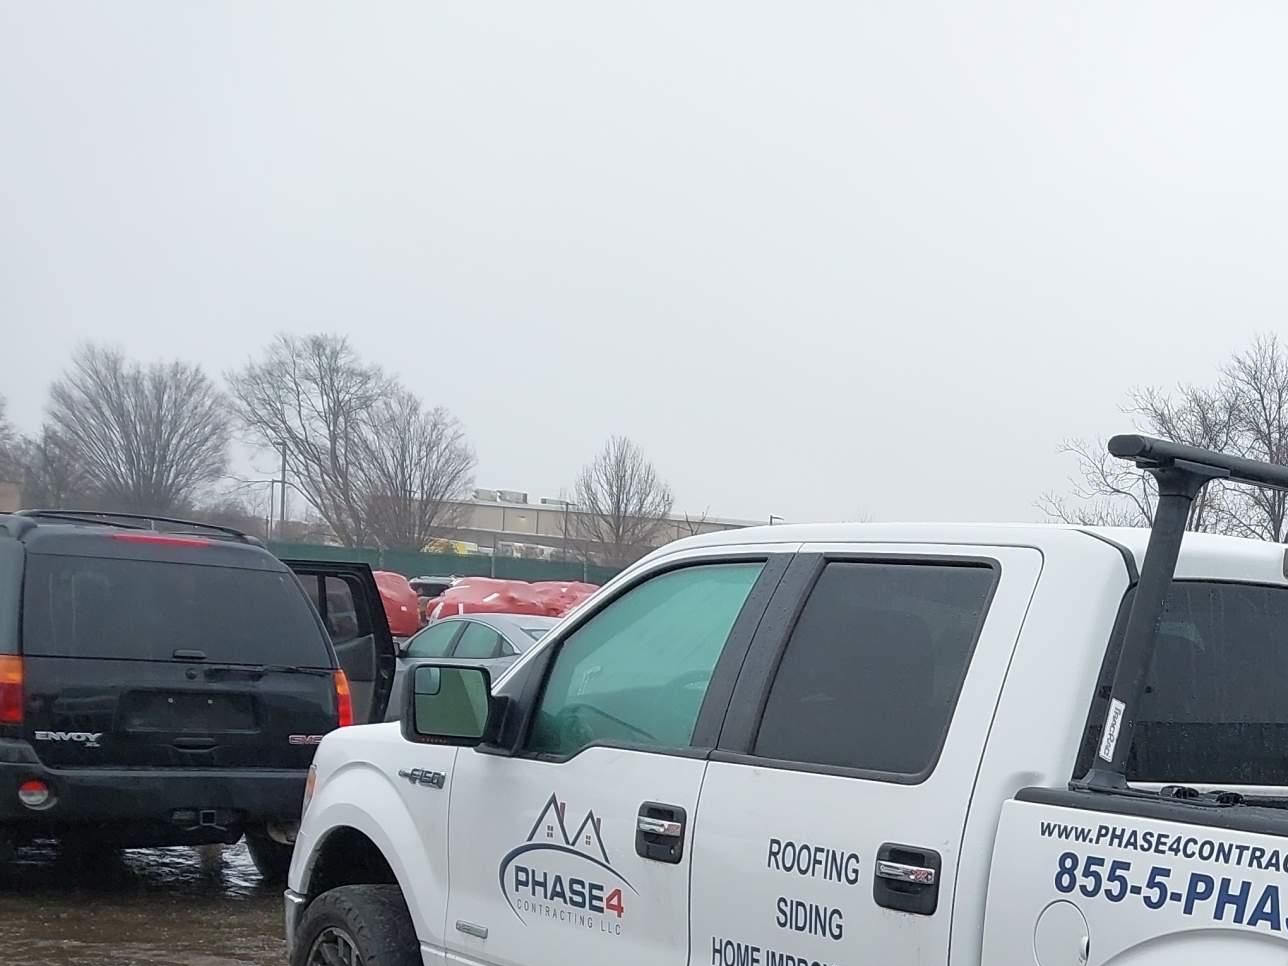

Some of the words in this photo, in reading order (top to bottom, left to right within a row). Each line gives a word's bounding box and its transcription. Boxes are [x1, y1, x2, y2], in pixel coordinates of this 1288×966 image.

[34, 731, 103, 742] ENVOY
[289, 735, 323, 745] GMC
[767, 838, 860, 885] ROOFING
[514, 864, 625, 919] PHASE4
[516, 898, 593, 929] CONTRACTING
[600, 920, 622, 936] LLC
[776, 896, 844, 941] SIDING
